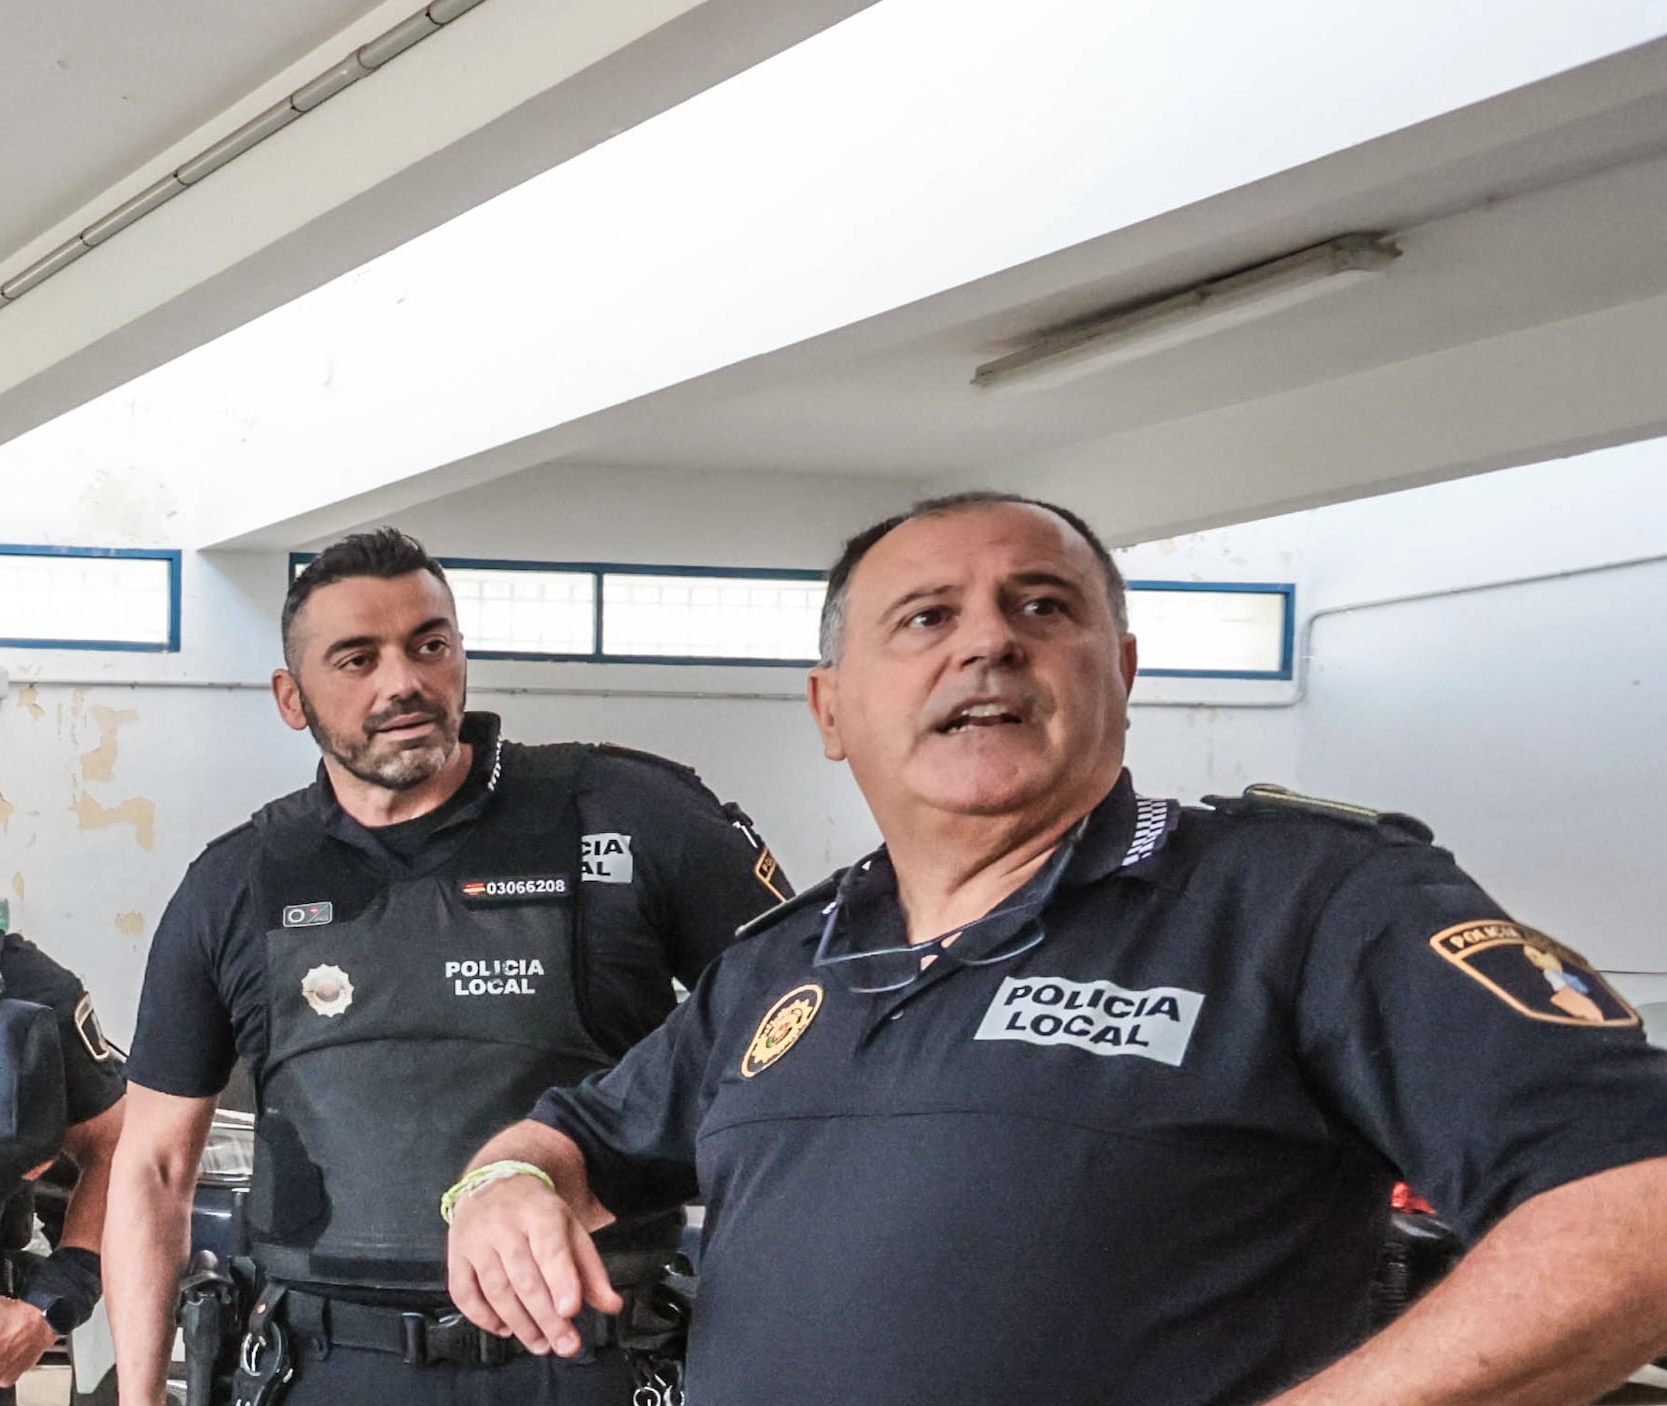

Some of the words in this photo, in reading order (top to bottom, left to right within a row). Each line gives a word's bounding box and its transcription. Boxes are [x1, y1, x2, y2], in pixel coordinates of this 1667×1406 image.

[581, 839, 624, 856] CIA
[581, 861, 612, 876] AL
[485, 879, 566, 895] 03066208
[445, 959, 545, 978] POLICIA
[455, 979, 535, 995] LOCAL
[1004, 984, 1181, 1022] POLICIA
[1005, 1011, 1149, 1047] LOCAL
